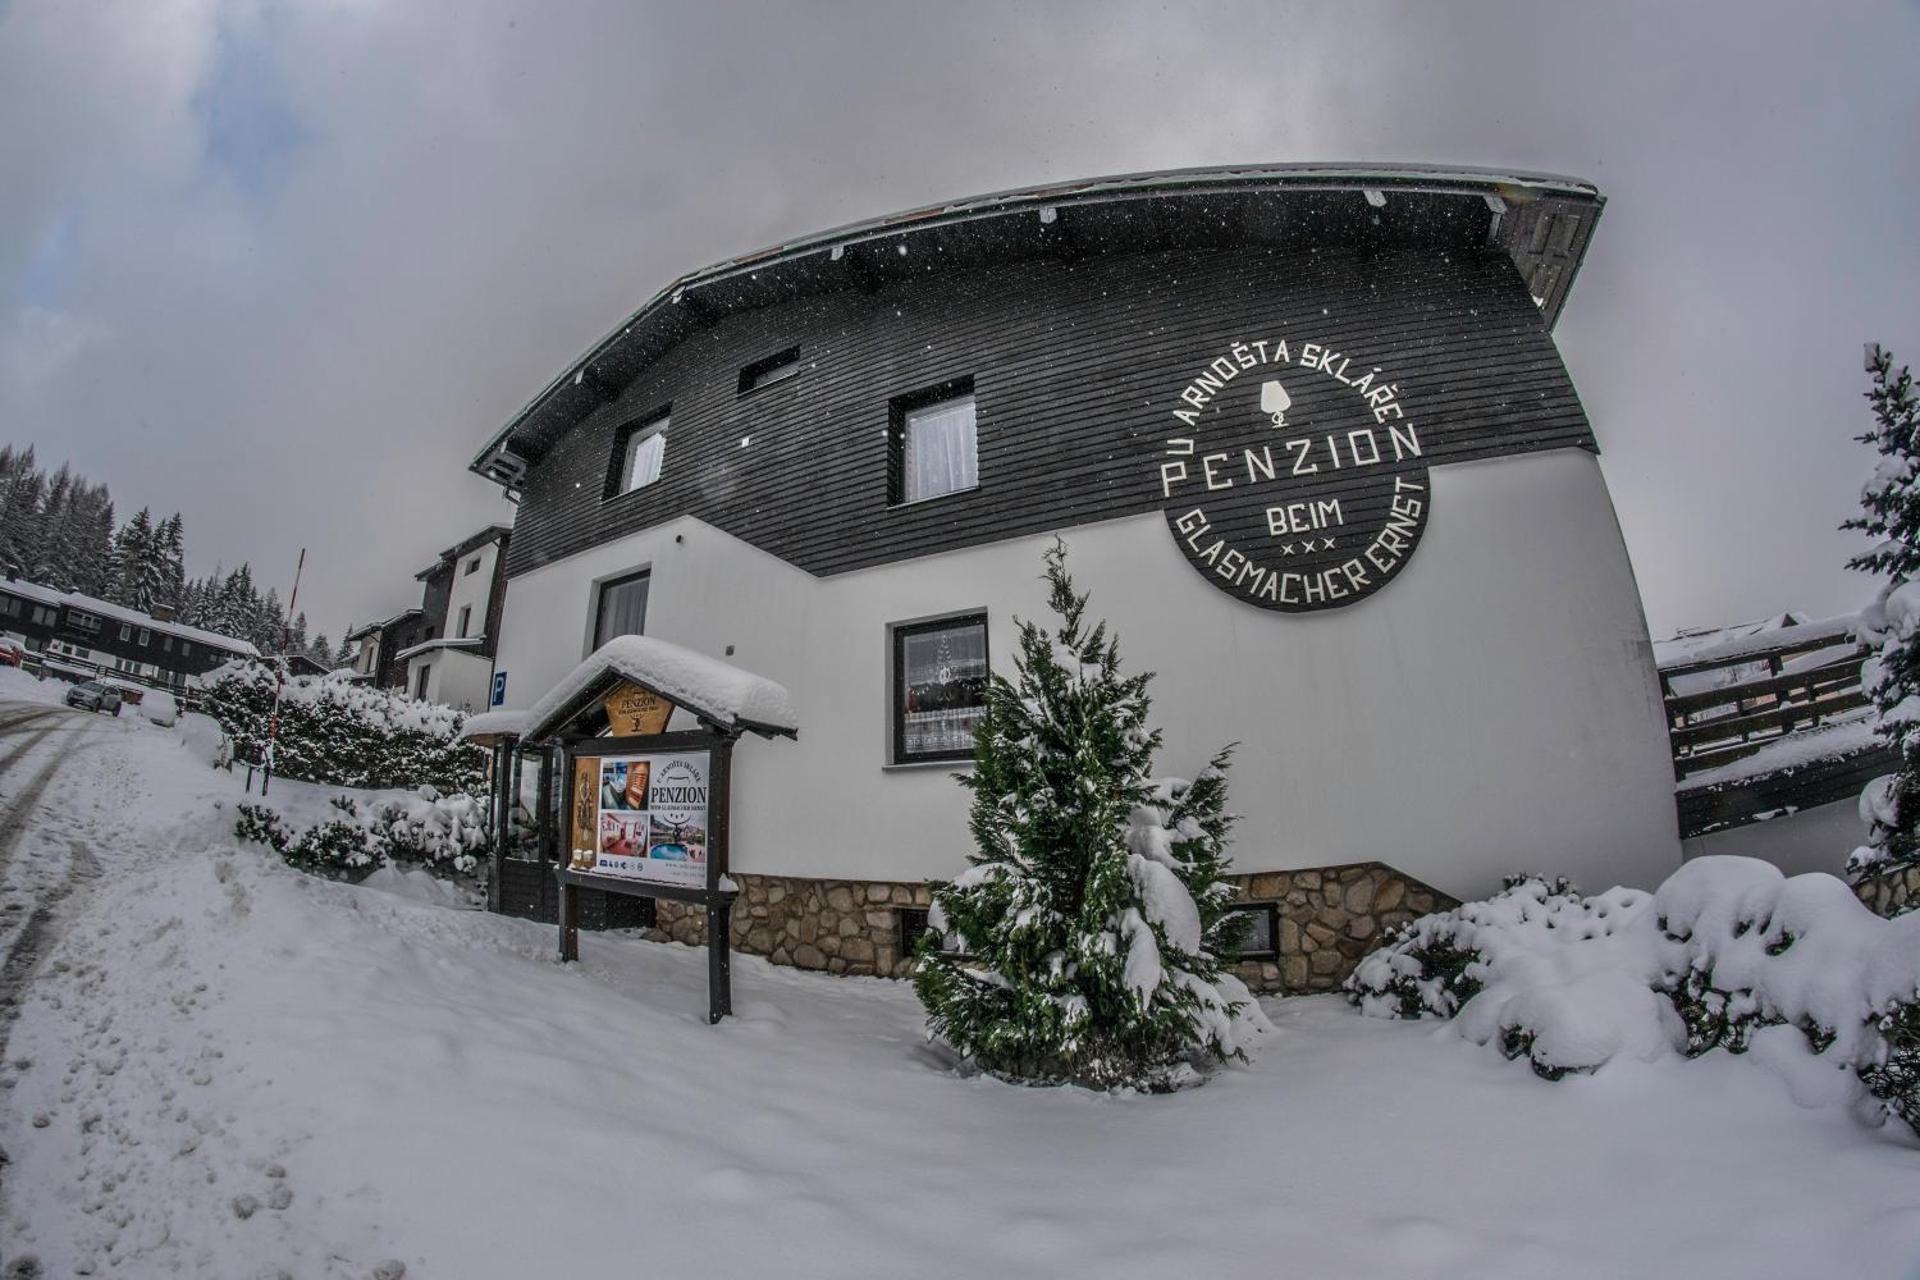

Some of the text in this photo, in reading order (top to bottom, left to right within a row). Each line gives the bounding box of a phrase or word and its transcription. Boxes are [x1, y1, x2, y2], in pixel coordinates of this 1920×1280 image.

[1167, 339, 1403, 455] U ARNOŠTA SKLÁŘE
[1161, 423, 1422, 498] PENZION
[1176, 477, 1424, 603] GLASMACHER ERNST
[1266, 499, 1344, 536] BEIM
[494, 676, 504, 702] P
[651, 786, 707, 803] PENZION
